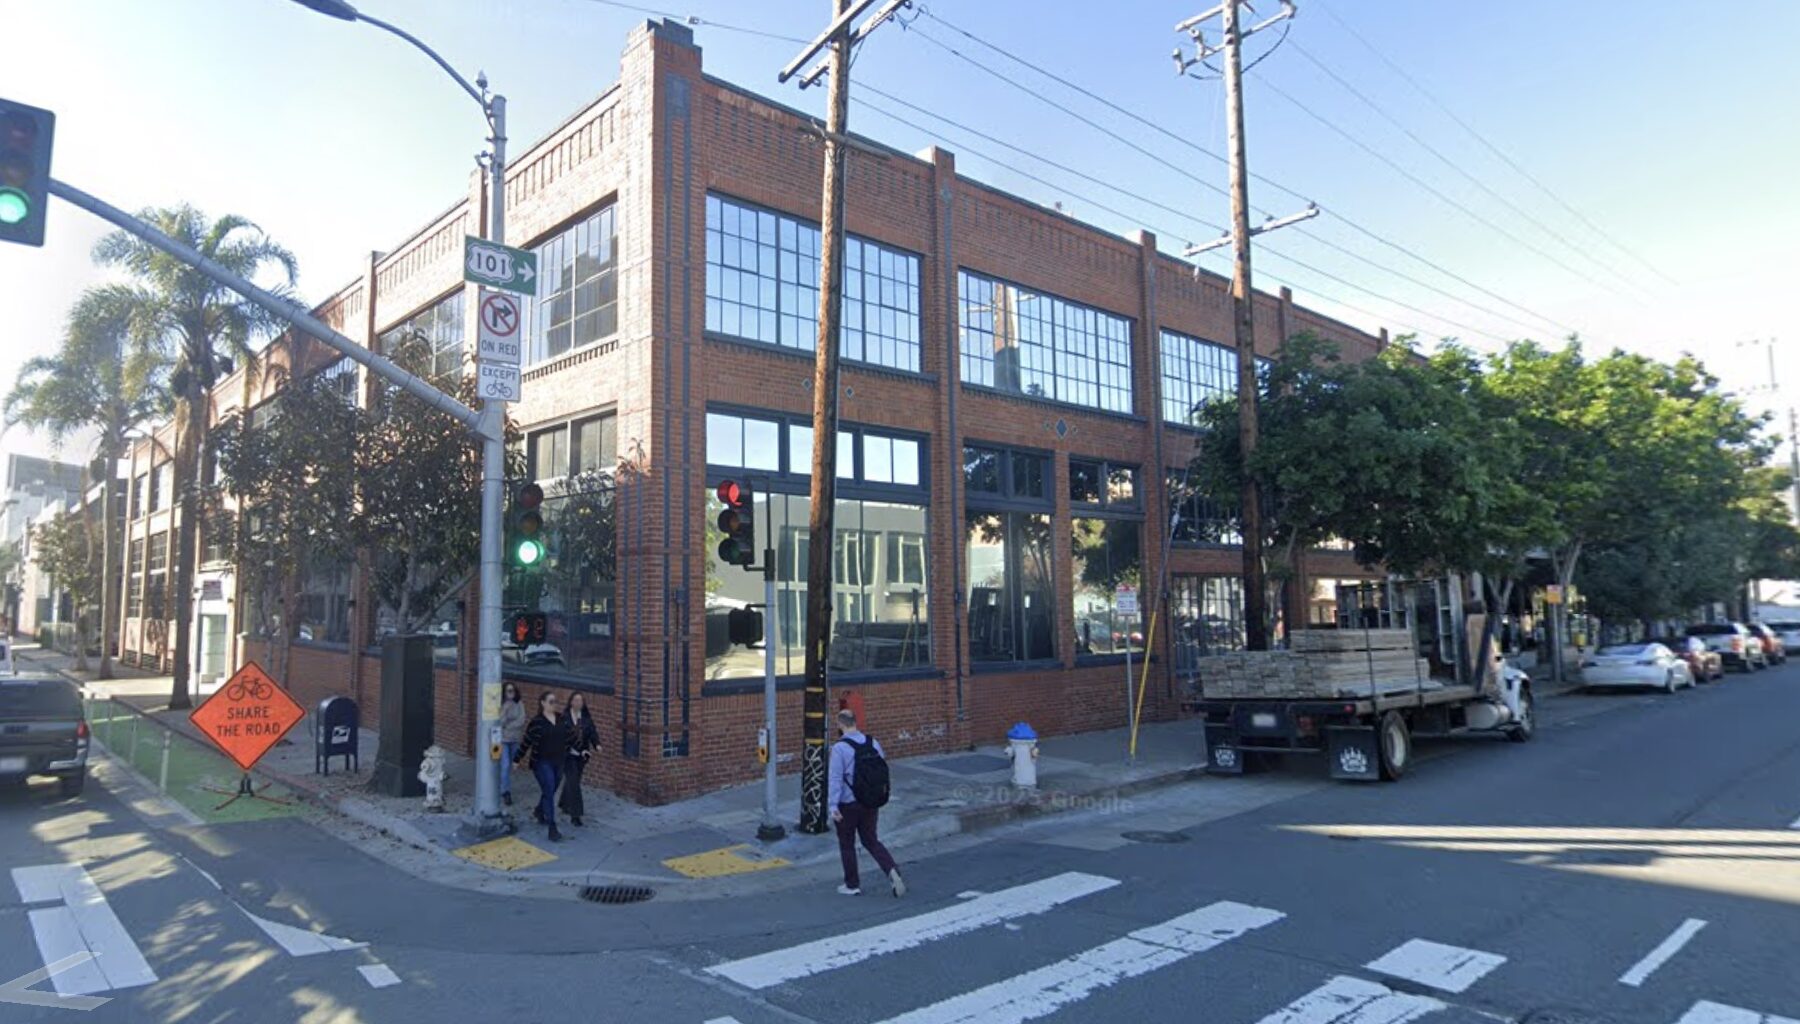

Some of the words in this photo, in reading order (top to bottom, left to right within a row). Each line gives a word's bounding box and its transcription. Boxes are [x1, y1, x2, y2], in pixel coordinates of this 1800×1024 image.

[476, 252, 506, 276] 101
[481, 339, 495, 352] ON
[498, 341, 517, 356] RED
[481, 366, 516, 381] EXCEPT
[227, 706, 270, 720] SHARE
[216, 724, 240, 737] THE
[245, 722, 281, 736] ROAD
